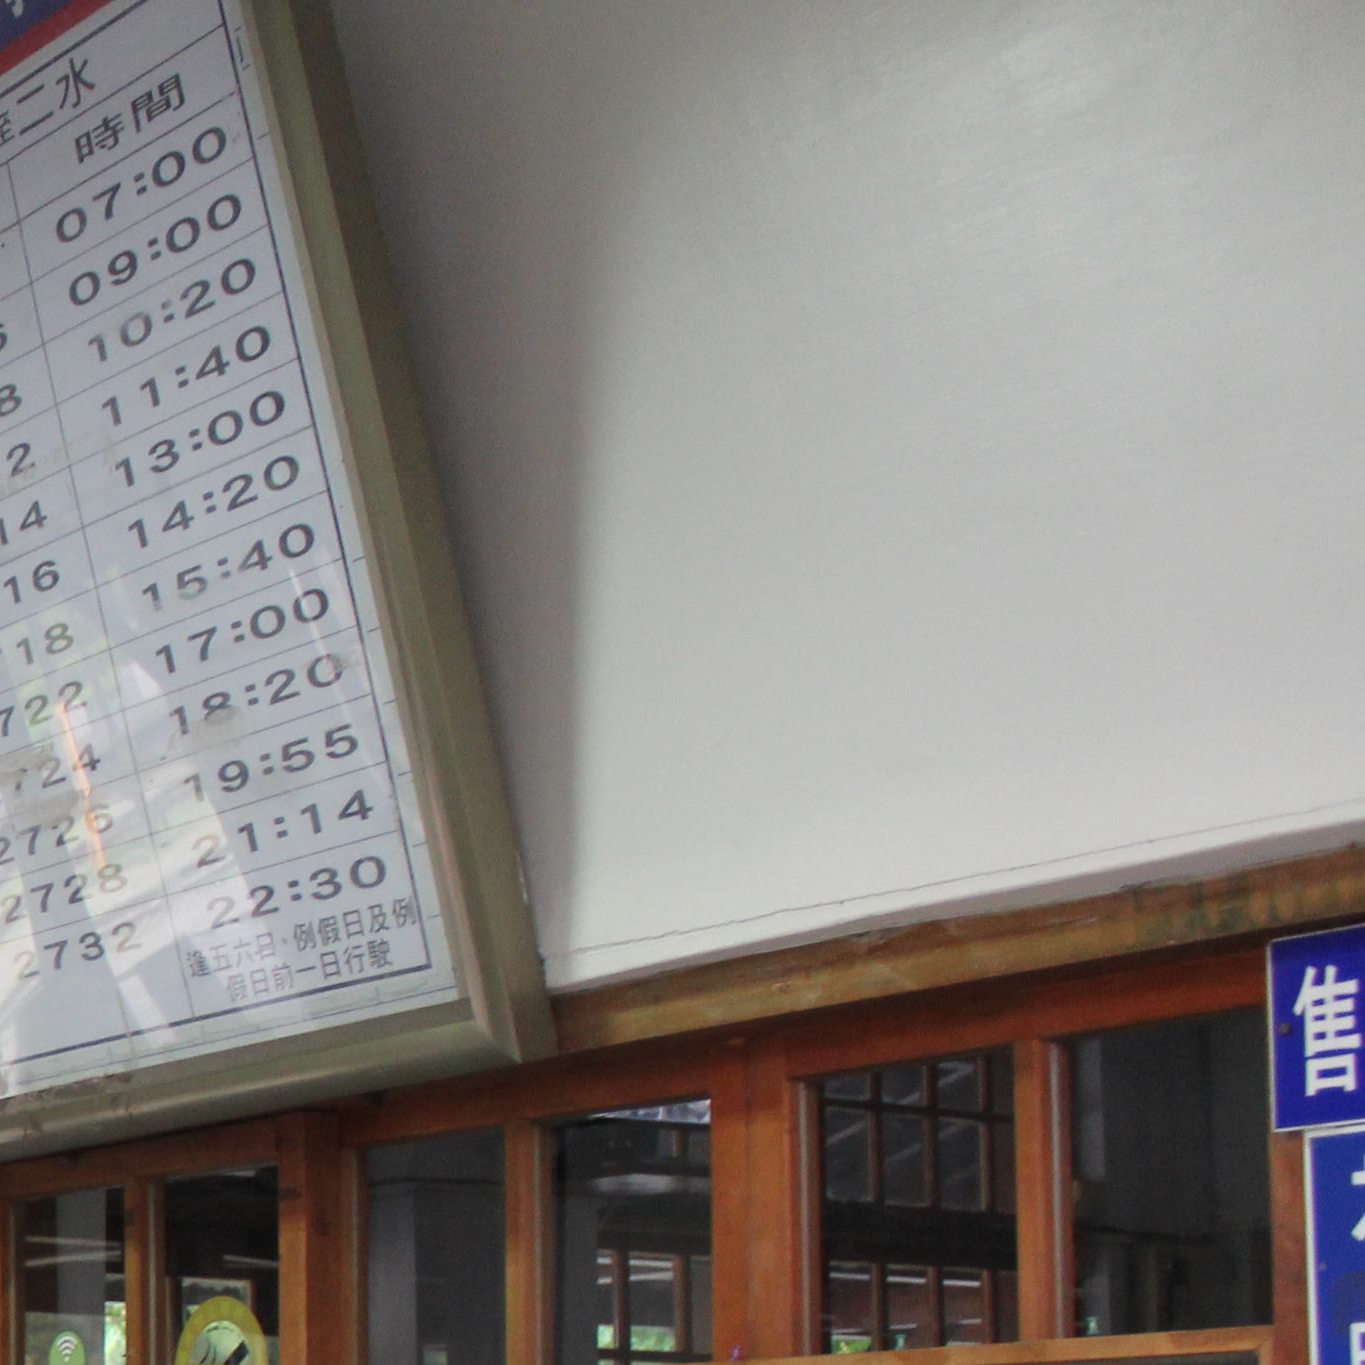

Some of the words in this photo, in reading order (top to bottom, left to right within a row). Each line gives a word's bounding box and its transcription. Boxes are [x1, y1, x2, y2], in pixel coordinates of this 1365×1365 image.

[75, 73, 187, 163] 時間
[56, 126, 228, 244] 07:00
[68, 194, 242, 306] 09:00
[88, 258, 257, 363] 10:20
[101, 325, 271, 427] 11:40
[114, 390, 287, 488] 13:00
[127, 455, 300, 549] 14:20
[142, 523, 315, 612] 15:40
[155, 588, 330, 674] 17:00
[183, 724, 359, 803] 19:55
[192, 789, 373, 868] 21:14
[1, 862, 128, 924] 2728
[206, 855, 387, 929] 22:30
[14, 921, 141, 981] 2732
[1292, 964, 1362, 1097] 售
